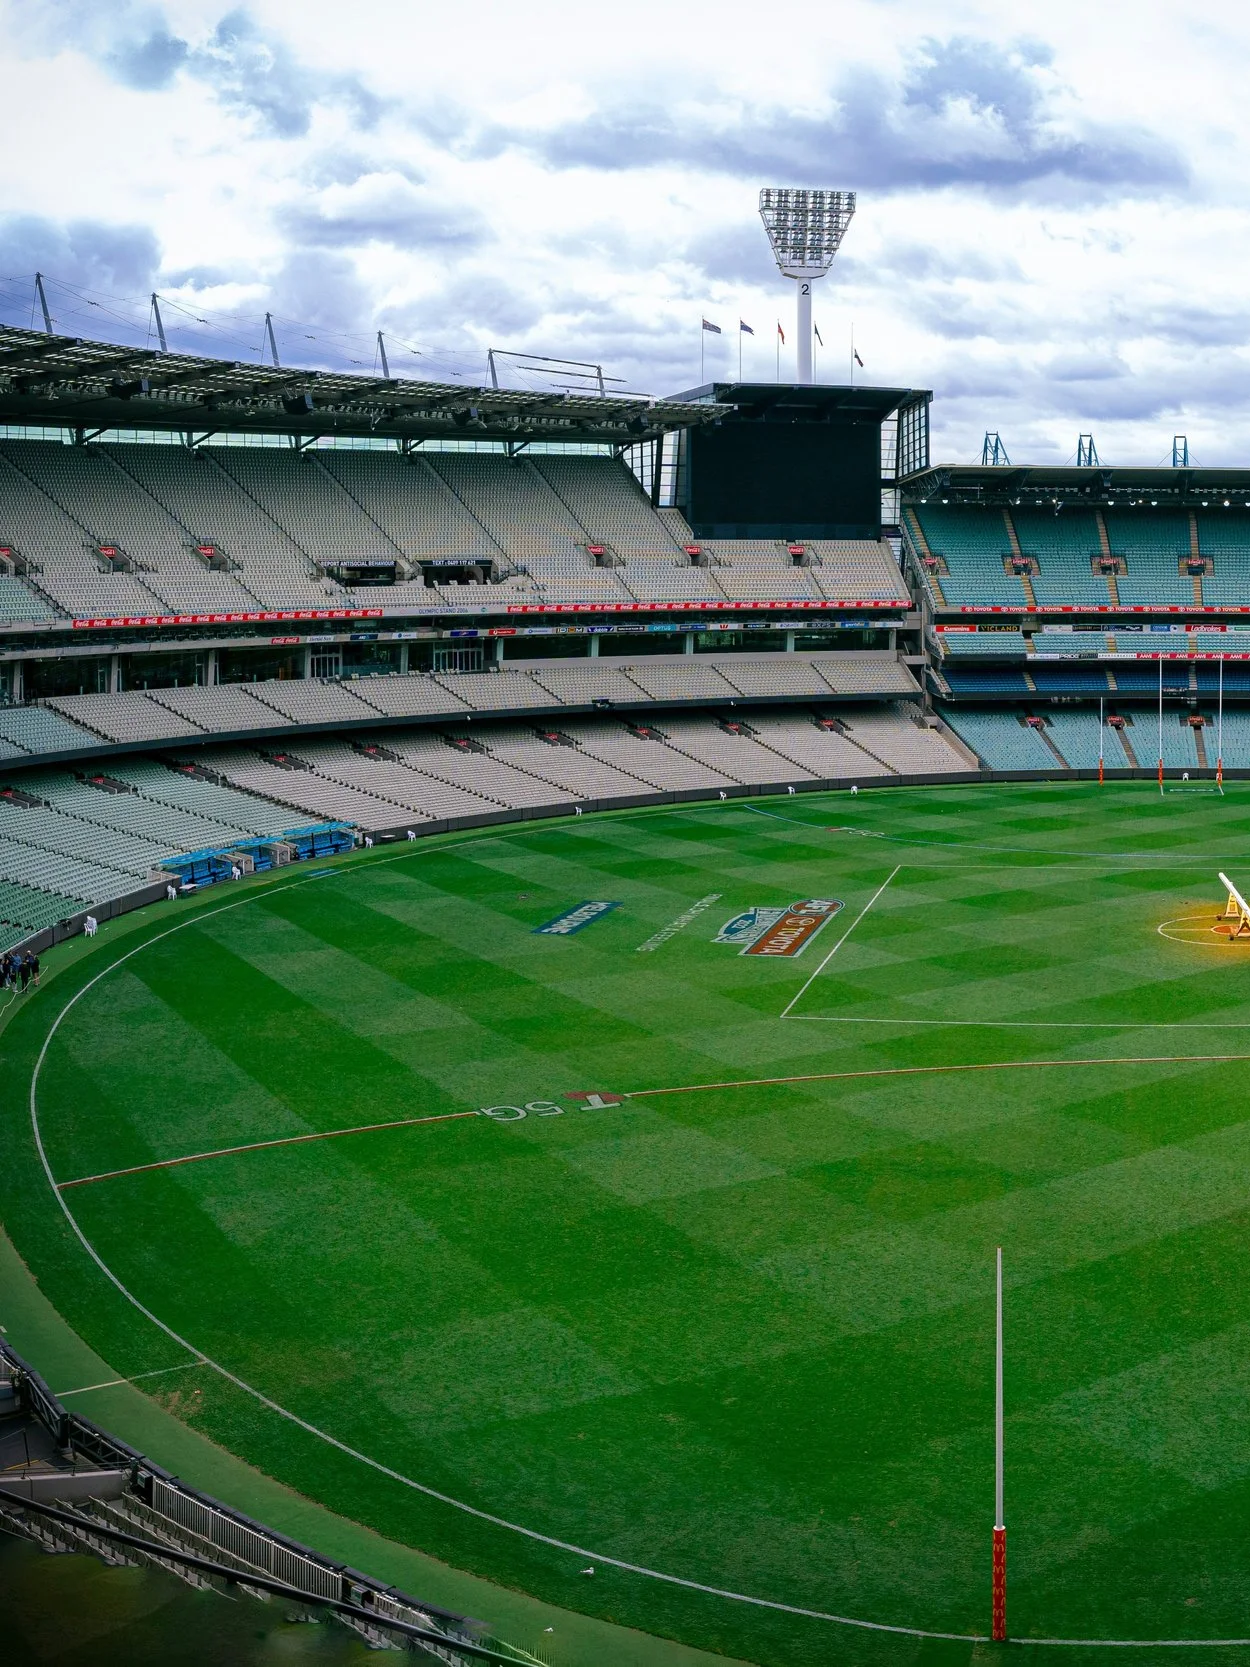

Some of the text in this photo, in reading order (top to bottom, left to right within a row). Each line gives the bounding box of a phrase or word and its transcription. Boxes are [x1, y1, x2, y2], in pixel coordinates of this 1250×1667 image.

[801, 284, 809, 295] 2
[800, 900, 833, 914] AFL
[759, 927, 805, 954] TOYOTA
